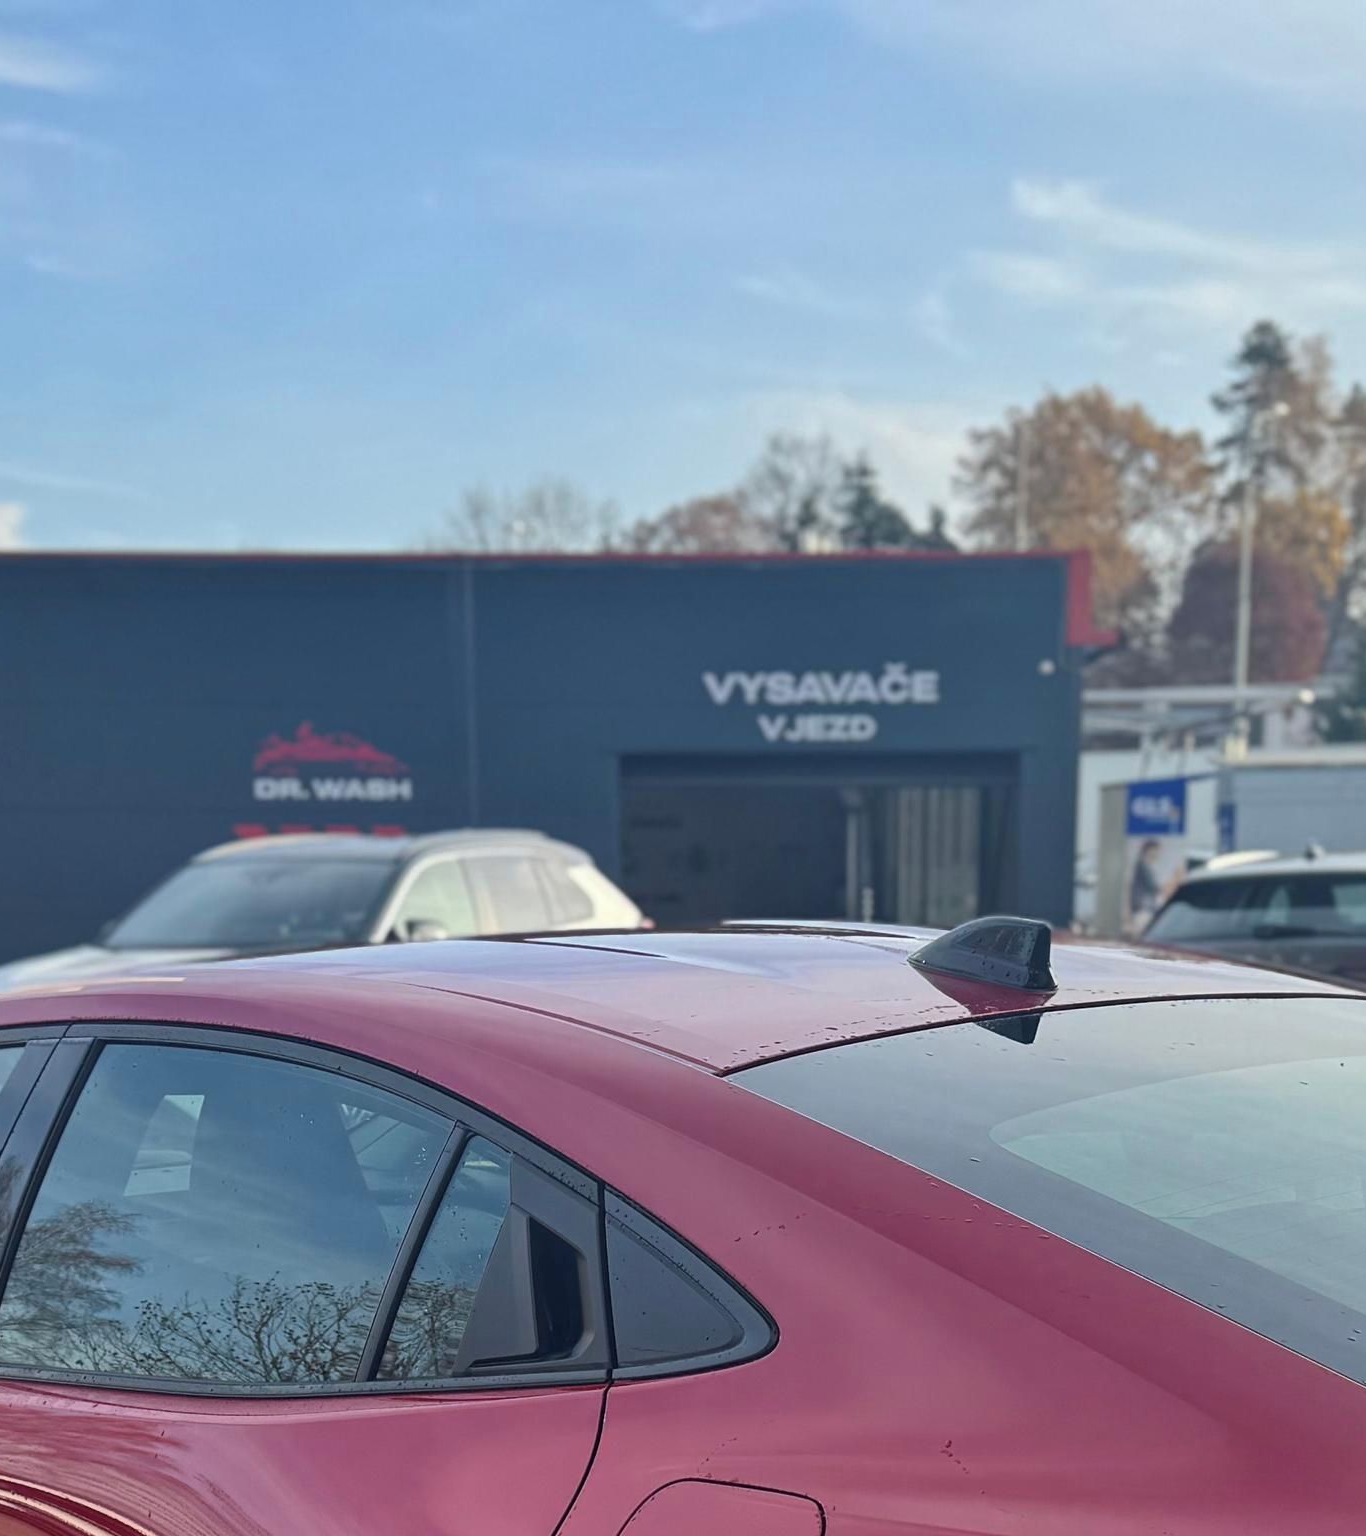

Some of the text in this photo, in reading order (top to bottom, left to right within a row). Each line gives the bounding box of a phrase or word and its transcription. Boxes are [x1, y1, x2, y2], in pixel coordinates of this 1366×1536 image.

[702, 662, 940, 705] VYSAVAČE
[757, 714, 878, 742] VJEZD
[311, 778, 412, 800] WASH
